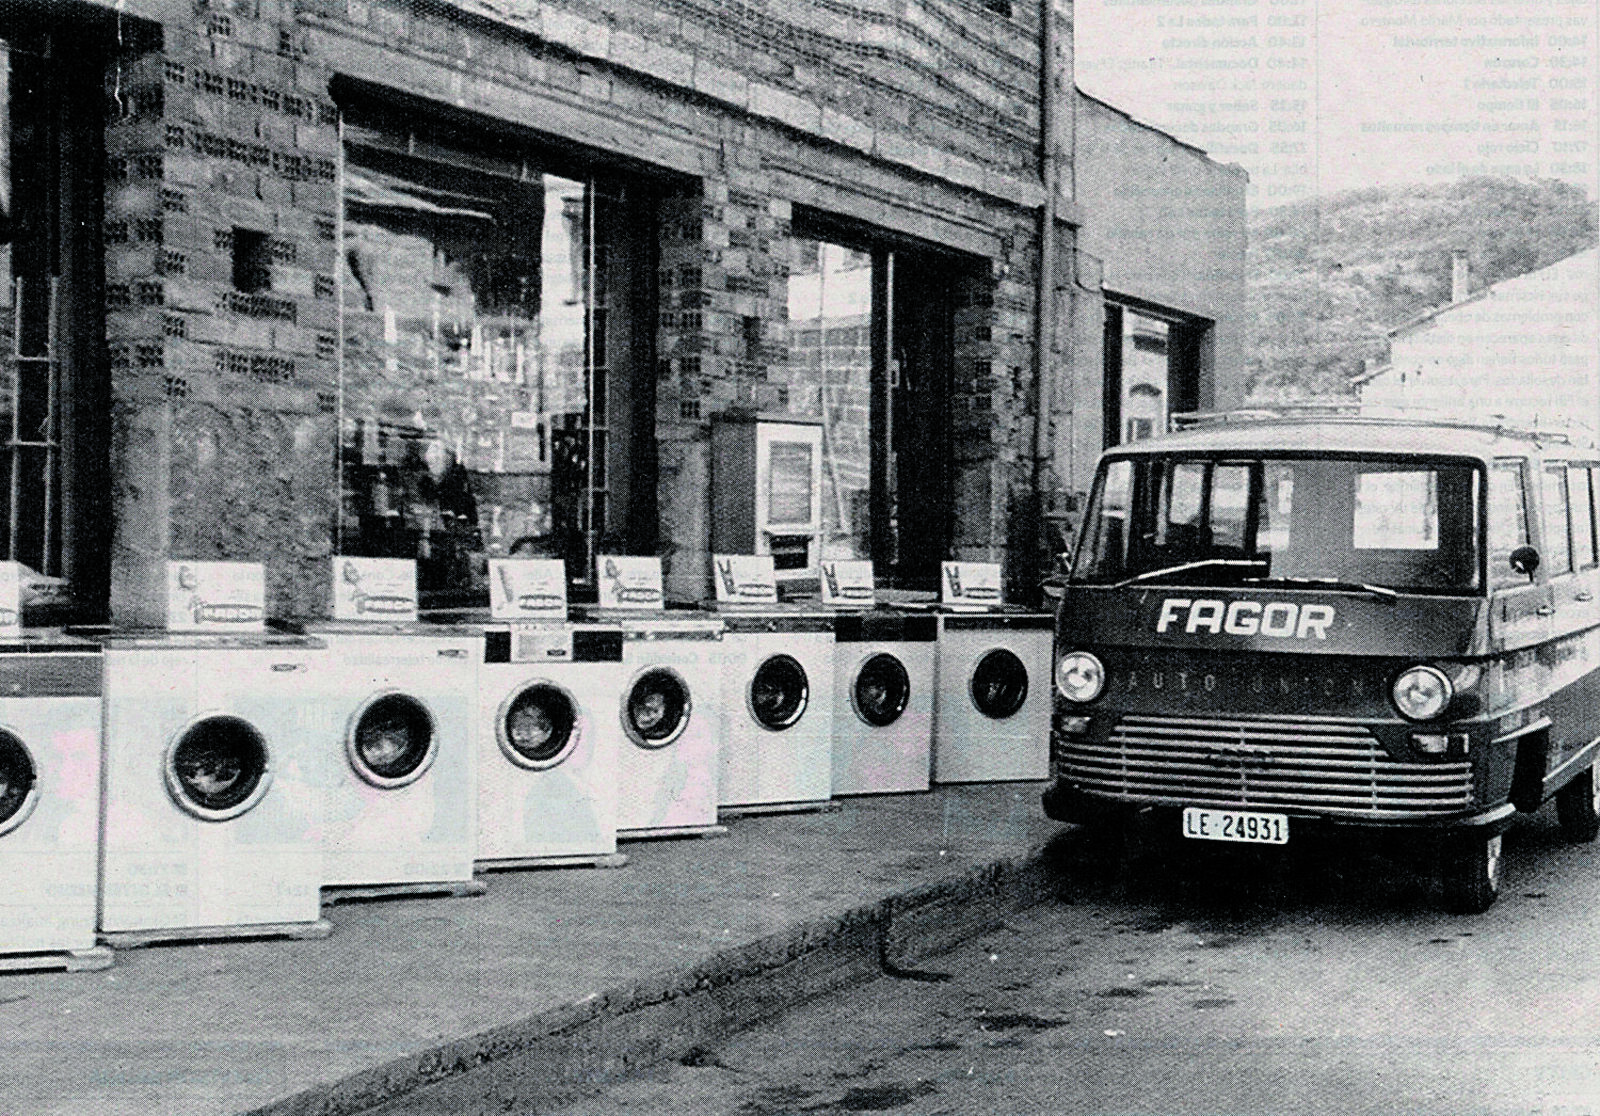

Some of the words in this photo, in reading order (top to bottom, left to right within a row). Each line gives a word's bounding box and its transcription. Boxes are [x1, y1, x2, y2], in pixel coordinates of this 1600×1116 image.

[1156, 598, 1336, 640] FAGOR
[1128, 671, 1217, 692] AUTO
[1252, 674, 1365, 697] UNON
[1186, 812, 1211, 836] LE
[1222, 814, 1282, 842] 24931
